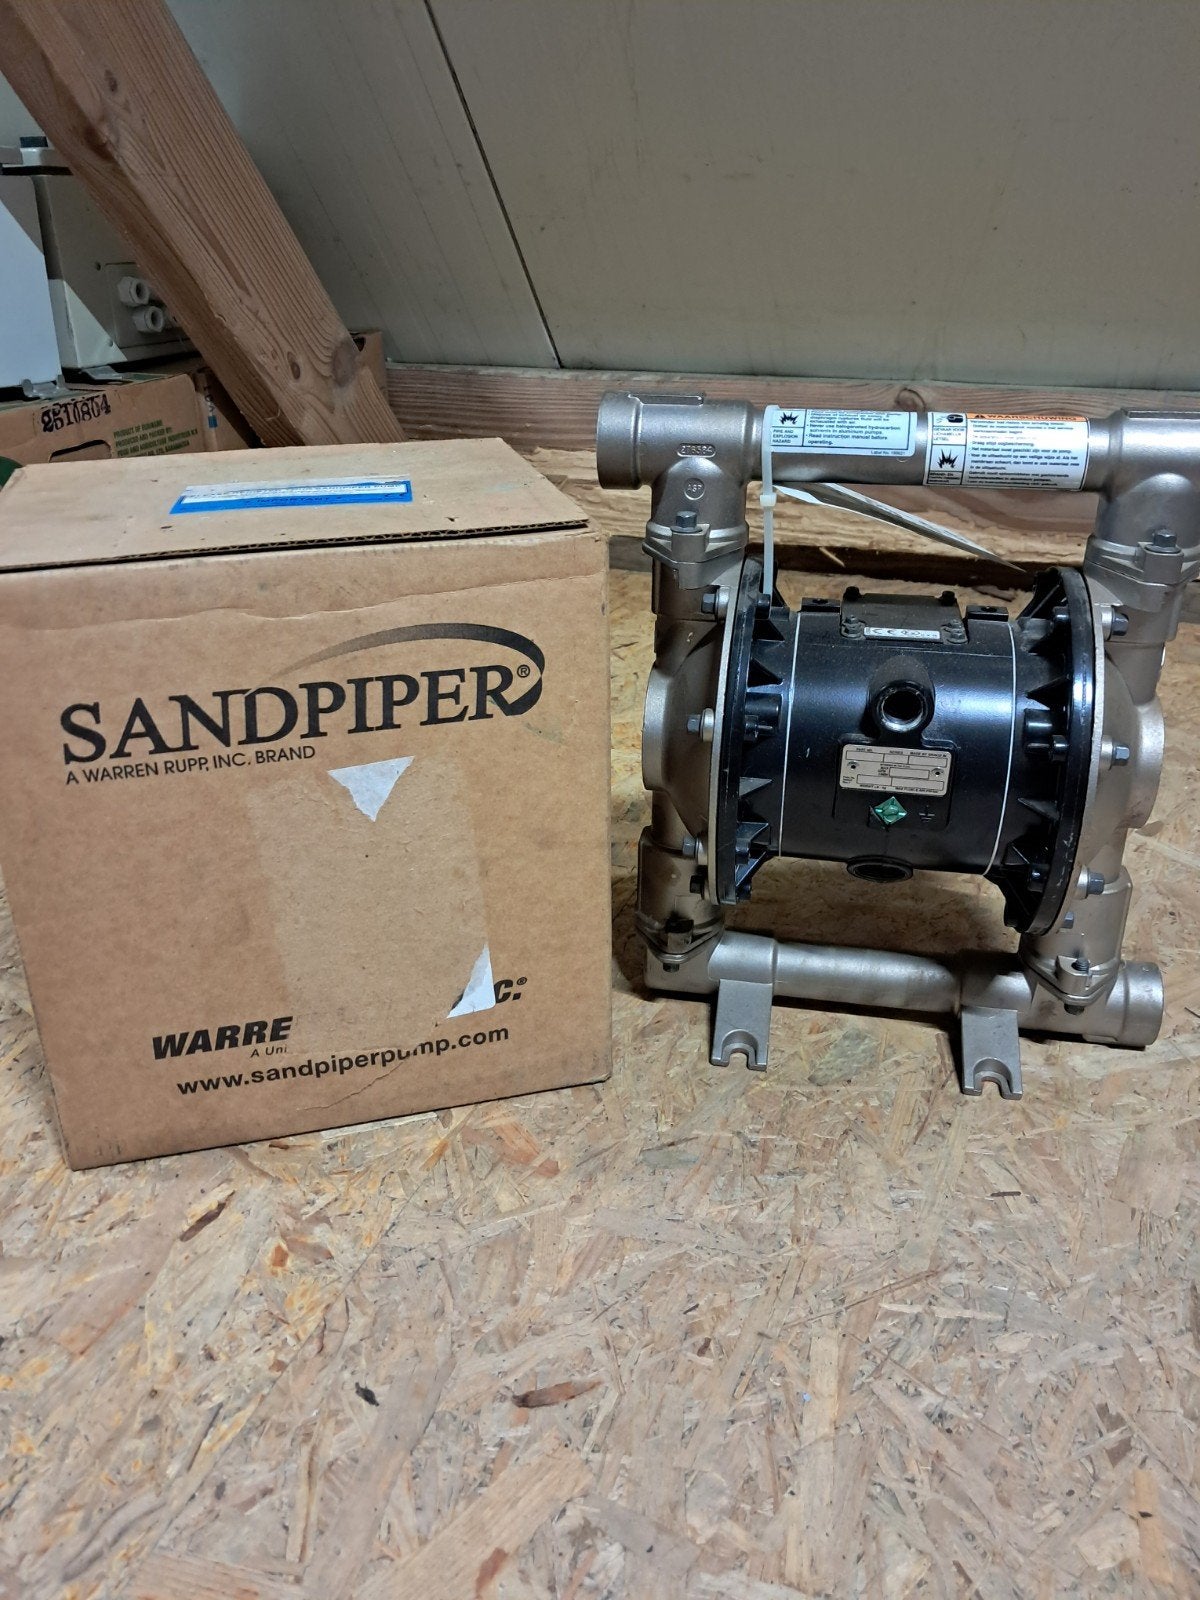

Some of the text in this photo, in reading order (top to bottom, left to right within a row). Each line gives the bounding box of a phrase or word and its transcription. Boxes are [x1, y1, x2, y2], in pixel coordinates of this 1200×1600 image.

[66, 745, 316, 785] A WARREN RUPP, INC. BRAND
[152, 1015, 294, 1060] WARRE
[250, 1048, 260, 1058] A
[176, 1027, 509, 1095] www.sandpiperpump.com
